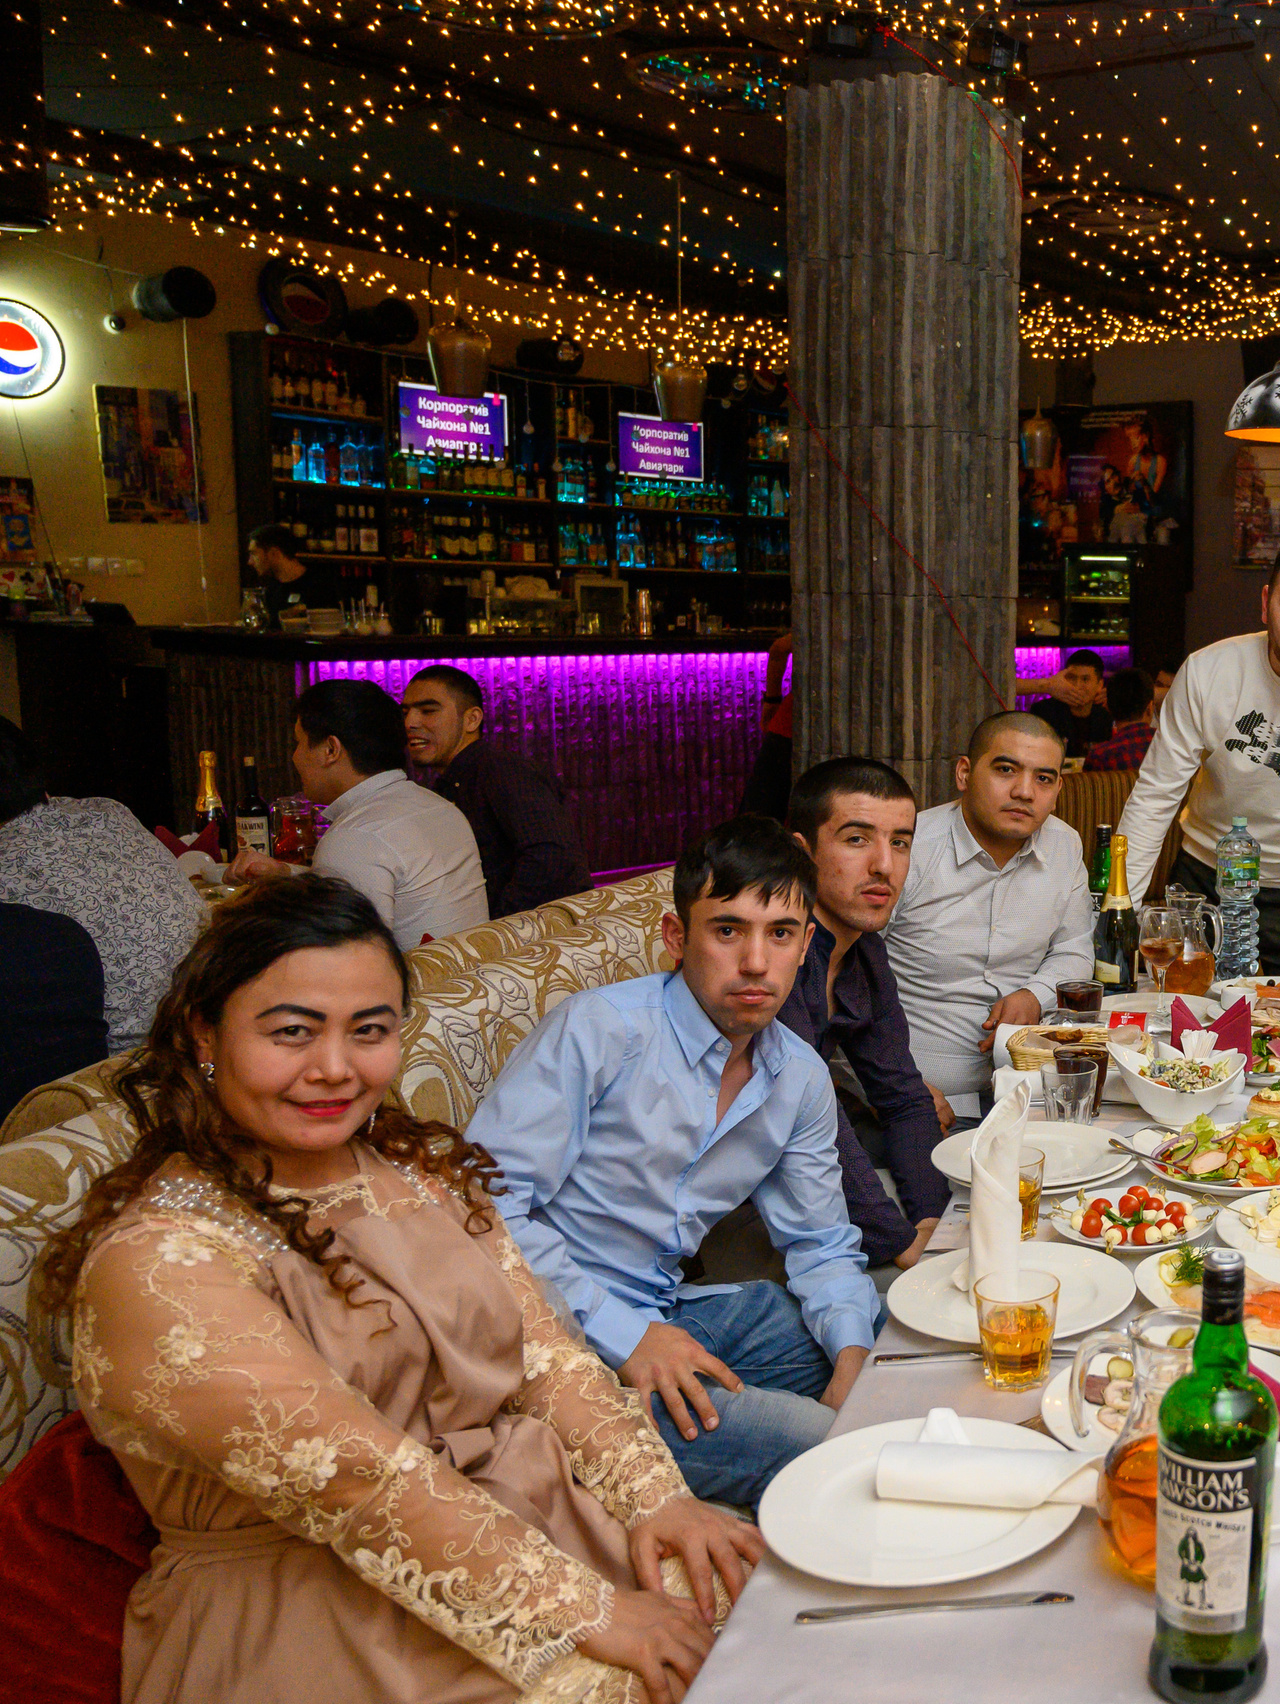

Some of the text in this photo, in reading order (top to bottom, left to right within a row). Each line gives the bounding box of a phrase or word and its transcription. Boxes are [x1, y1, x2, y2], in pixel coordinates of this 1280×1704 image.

[418, 396, 489, 417] Корпоратив
[416, 415, 491, 436] Чайхона №1
[425, 435, 483, 454] Авиапр
[632, 441, 690, 458] Чайхона №1
[639, 459, 685, 475] Авиапарк
[1161, 1456, 1244, 1491] WILLIAM
[1161, 1477, 1250, 1512] AWSON'S
